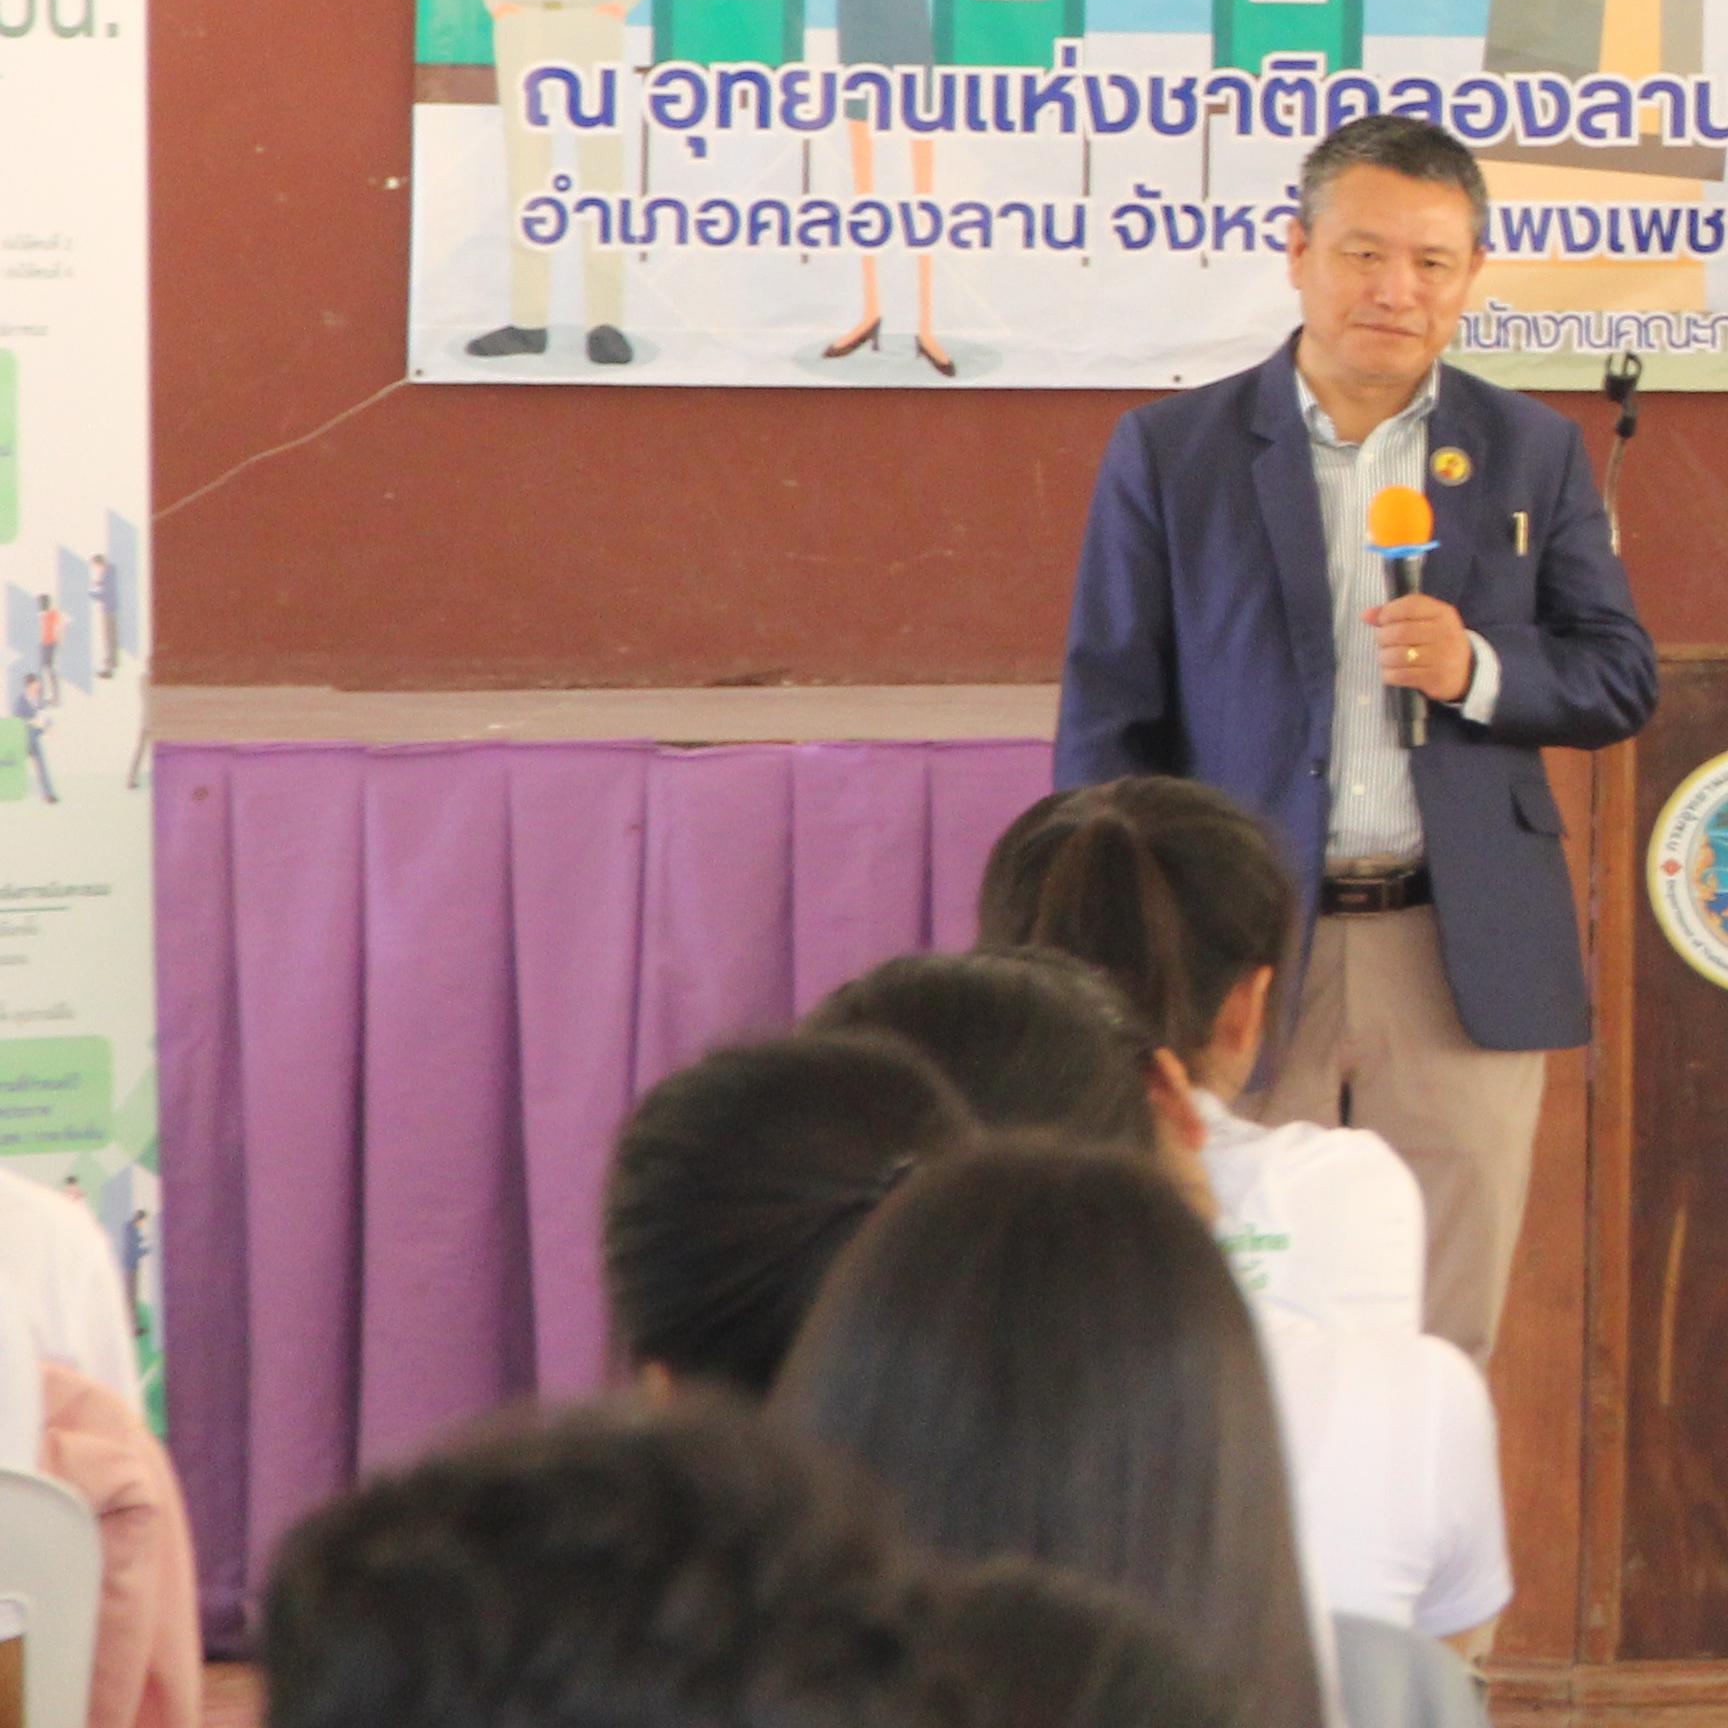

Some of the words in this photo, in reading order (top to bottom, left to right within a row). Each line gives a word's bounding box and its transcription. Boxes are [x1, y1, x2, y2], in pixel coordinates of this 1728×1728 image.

[524, 64, 616, 132] ณ
[521, 177, 1084, 264] อำเภอคลองลาน
